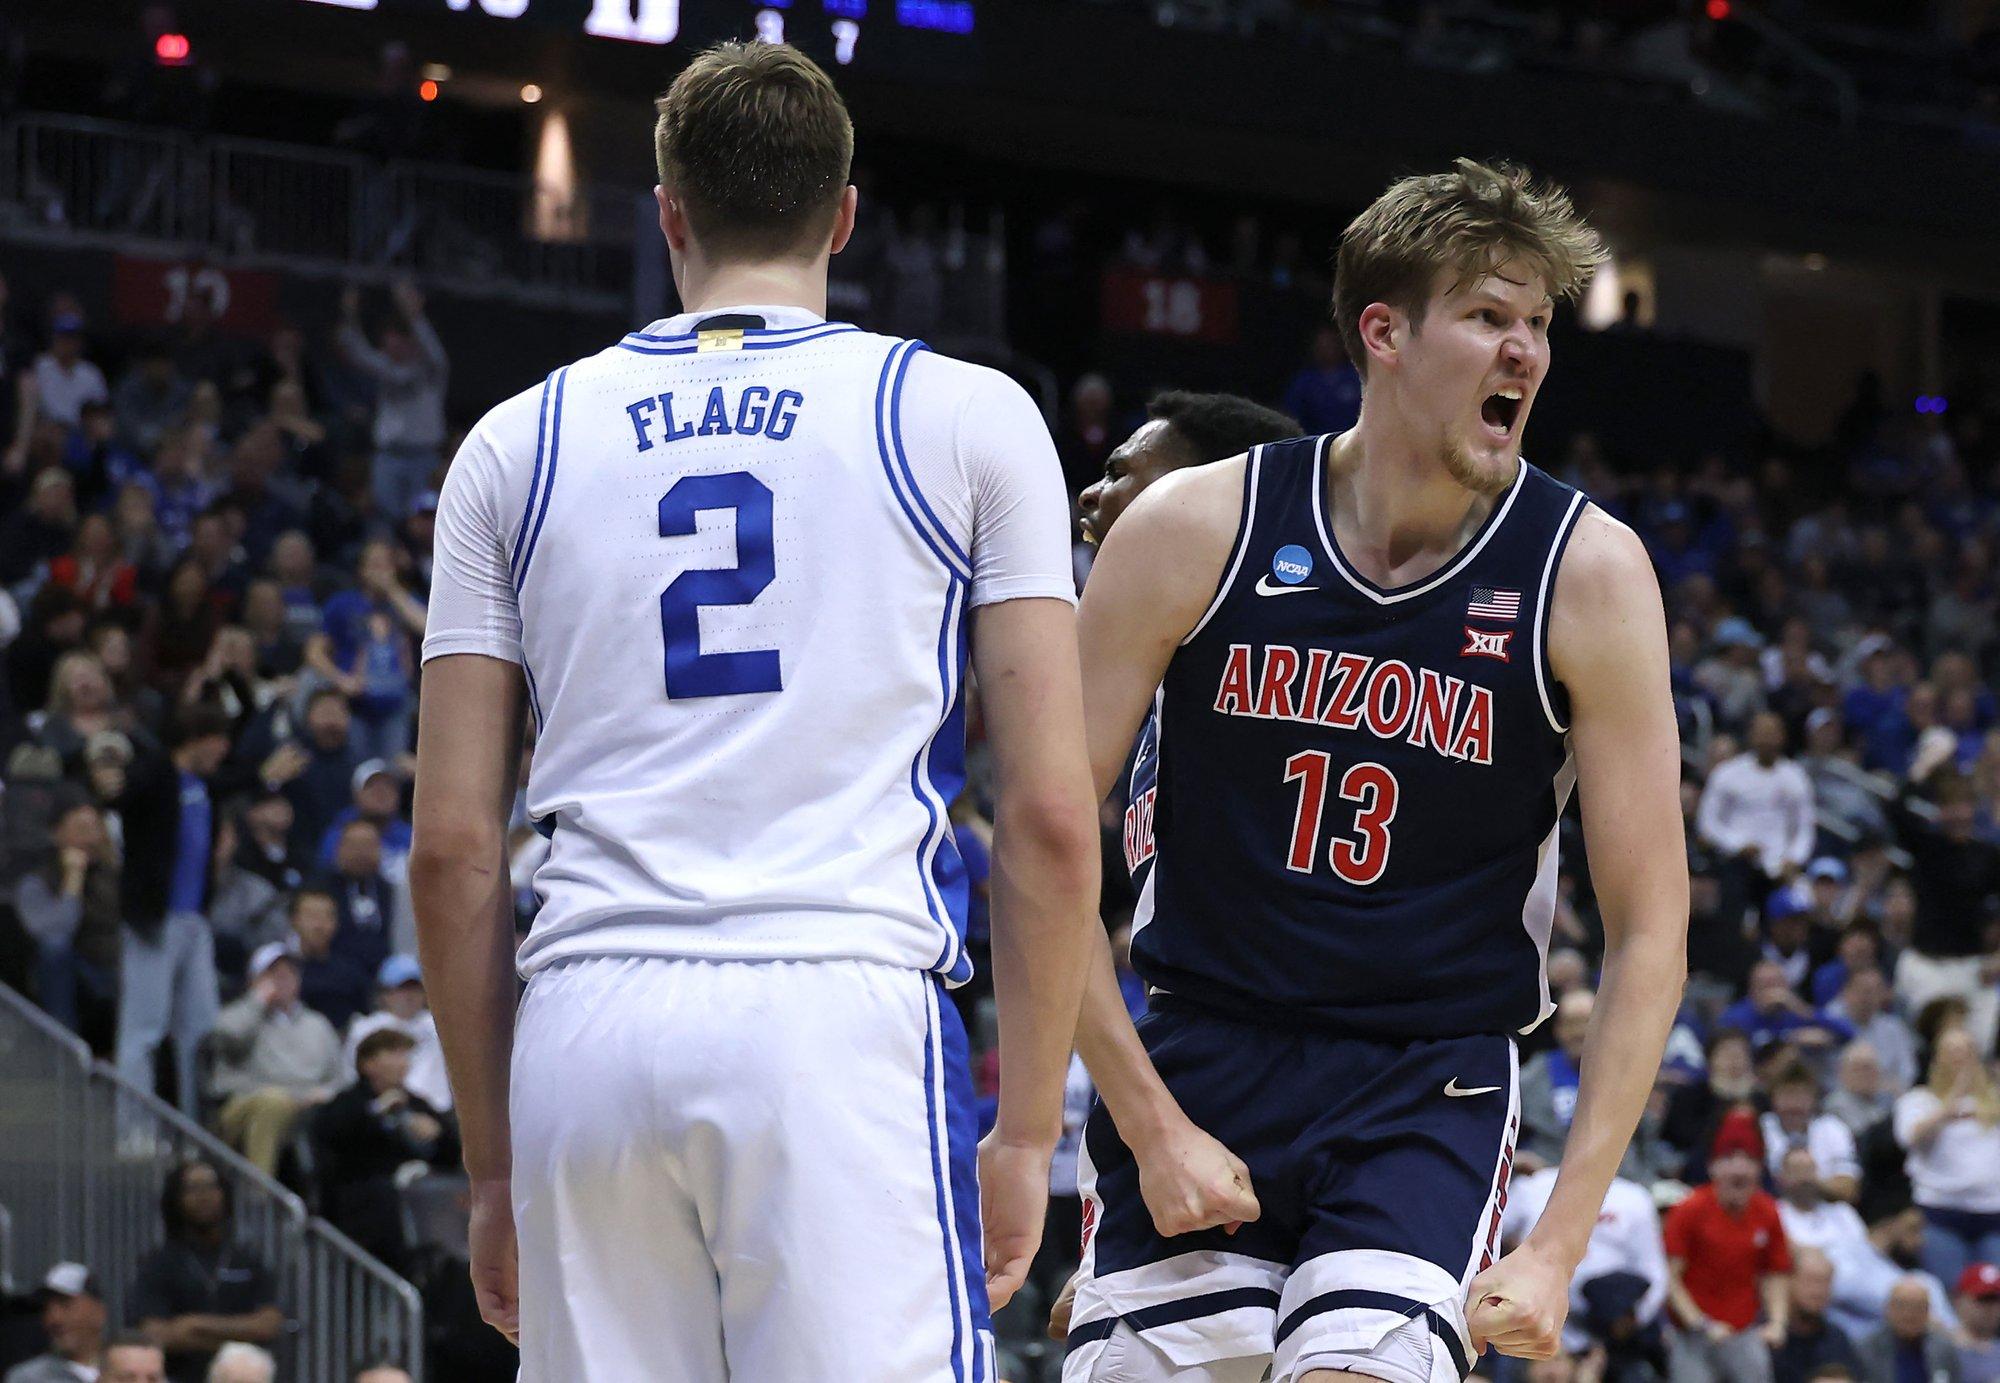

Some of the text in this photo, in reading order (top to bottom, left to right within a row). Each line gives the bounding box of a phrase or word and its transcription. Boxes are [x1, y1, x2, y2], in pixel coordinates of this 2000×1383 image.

[1143, 279, 1201, 334] 18
[625, 386, 804, 453] FLAGG
[658, 471, 783, 700] 2
[1276, 560, 1309, 577] NCAA
[1462, 627, 1511, 660] XII
[1213, 644, 1493, 765] ARIZONA
[1283, 749, 1399, 886] 13
